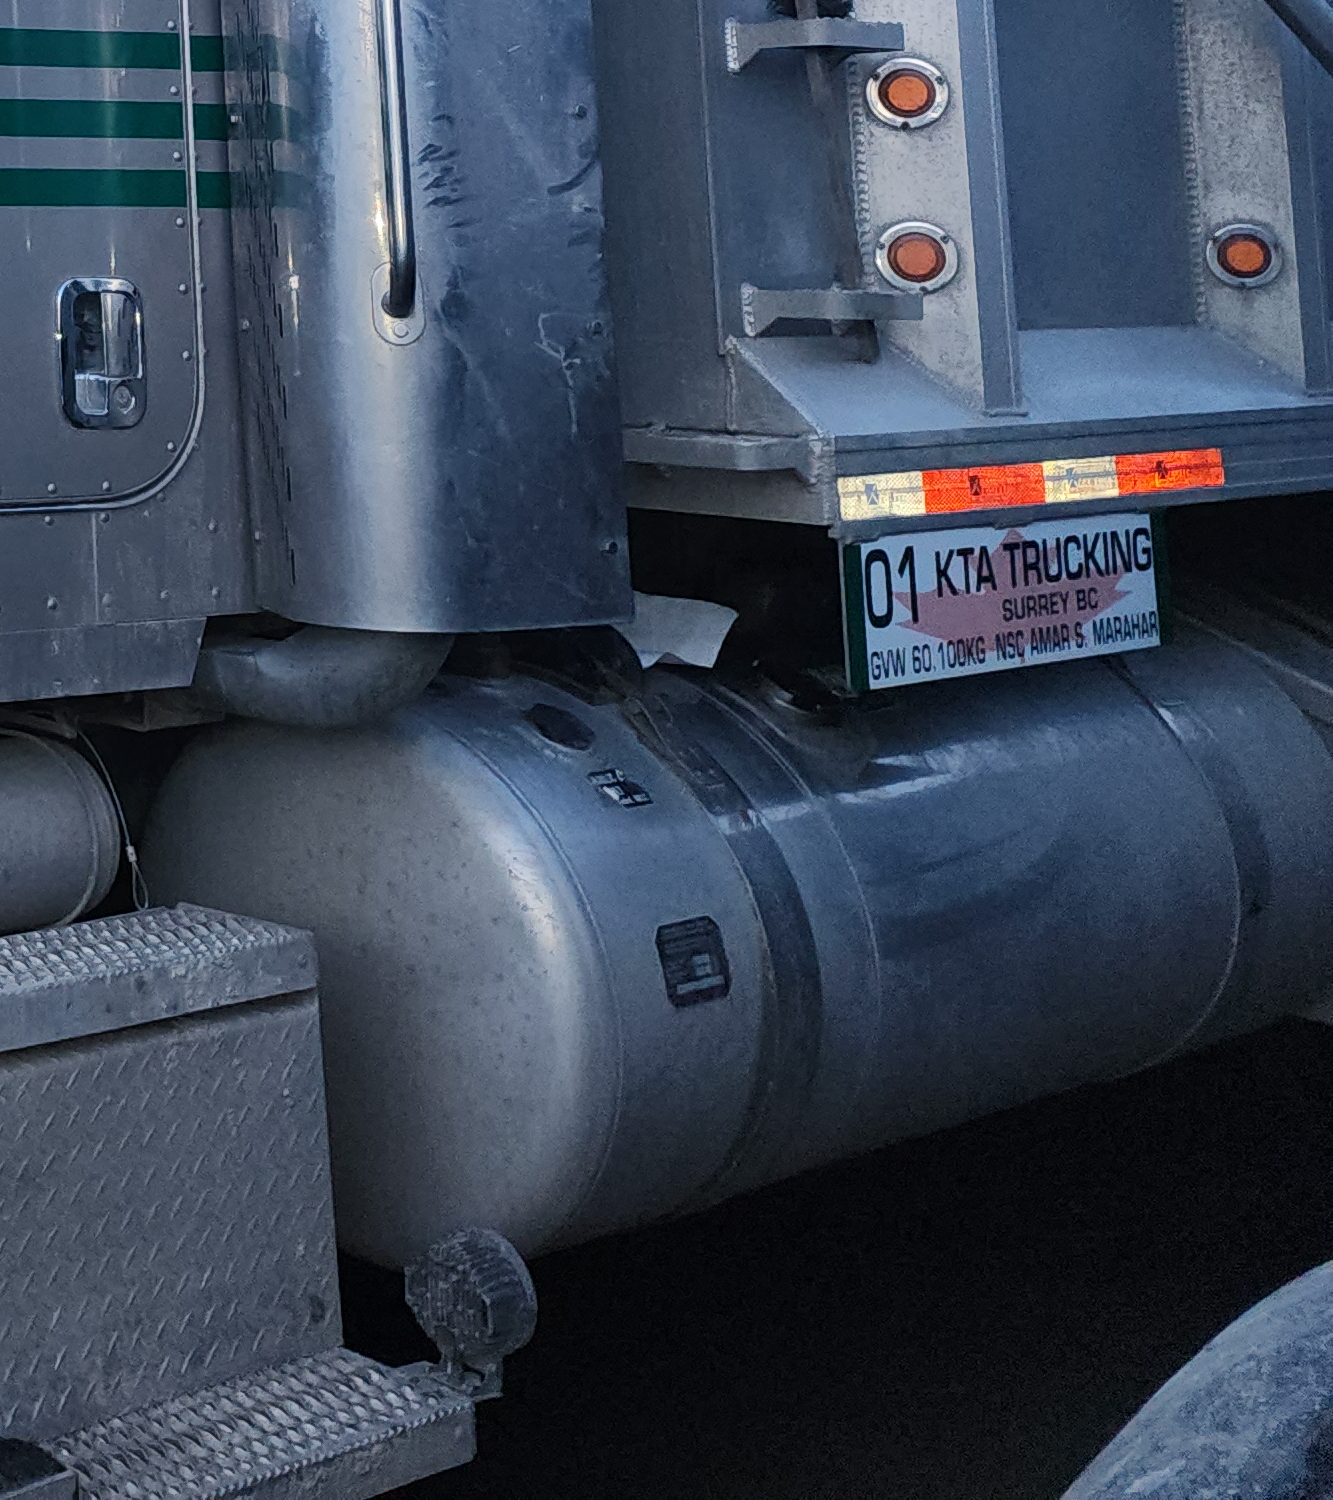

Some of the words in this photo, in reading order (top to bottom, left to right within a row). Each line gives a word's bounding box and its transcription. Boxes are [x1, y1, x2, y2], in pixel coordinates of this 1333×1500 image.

[864, 546, 919, 628] 01
[935, 545, 997, 598] KTA
[1002, 527, 1152, 589] TRUCKING
[1002, 591, 1069, 622] SURREY
[1076, 587, 1099, 611] BC
[870, 647, 906, 680] GVW
[994, 629, 1025, 661] NSC
[1030, 623, 1071, 656] AMAR
[1092, 610, 1158, 646] MARAHAR
